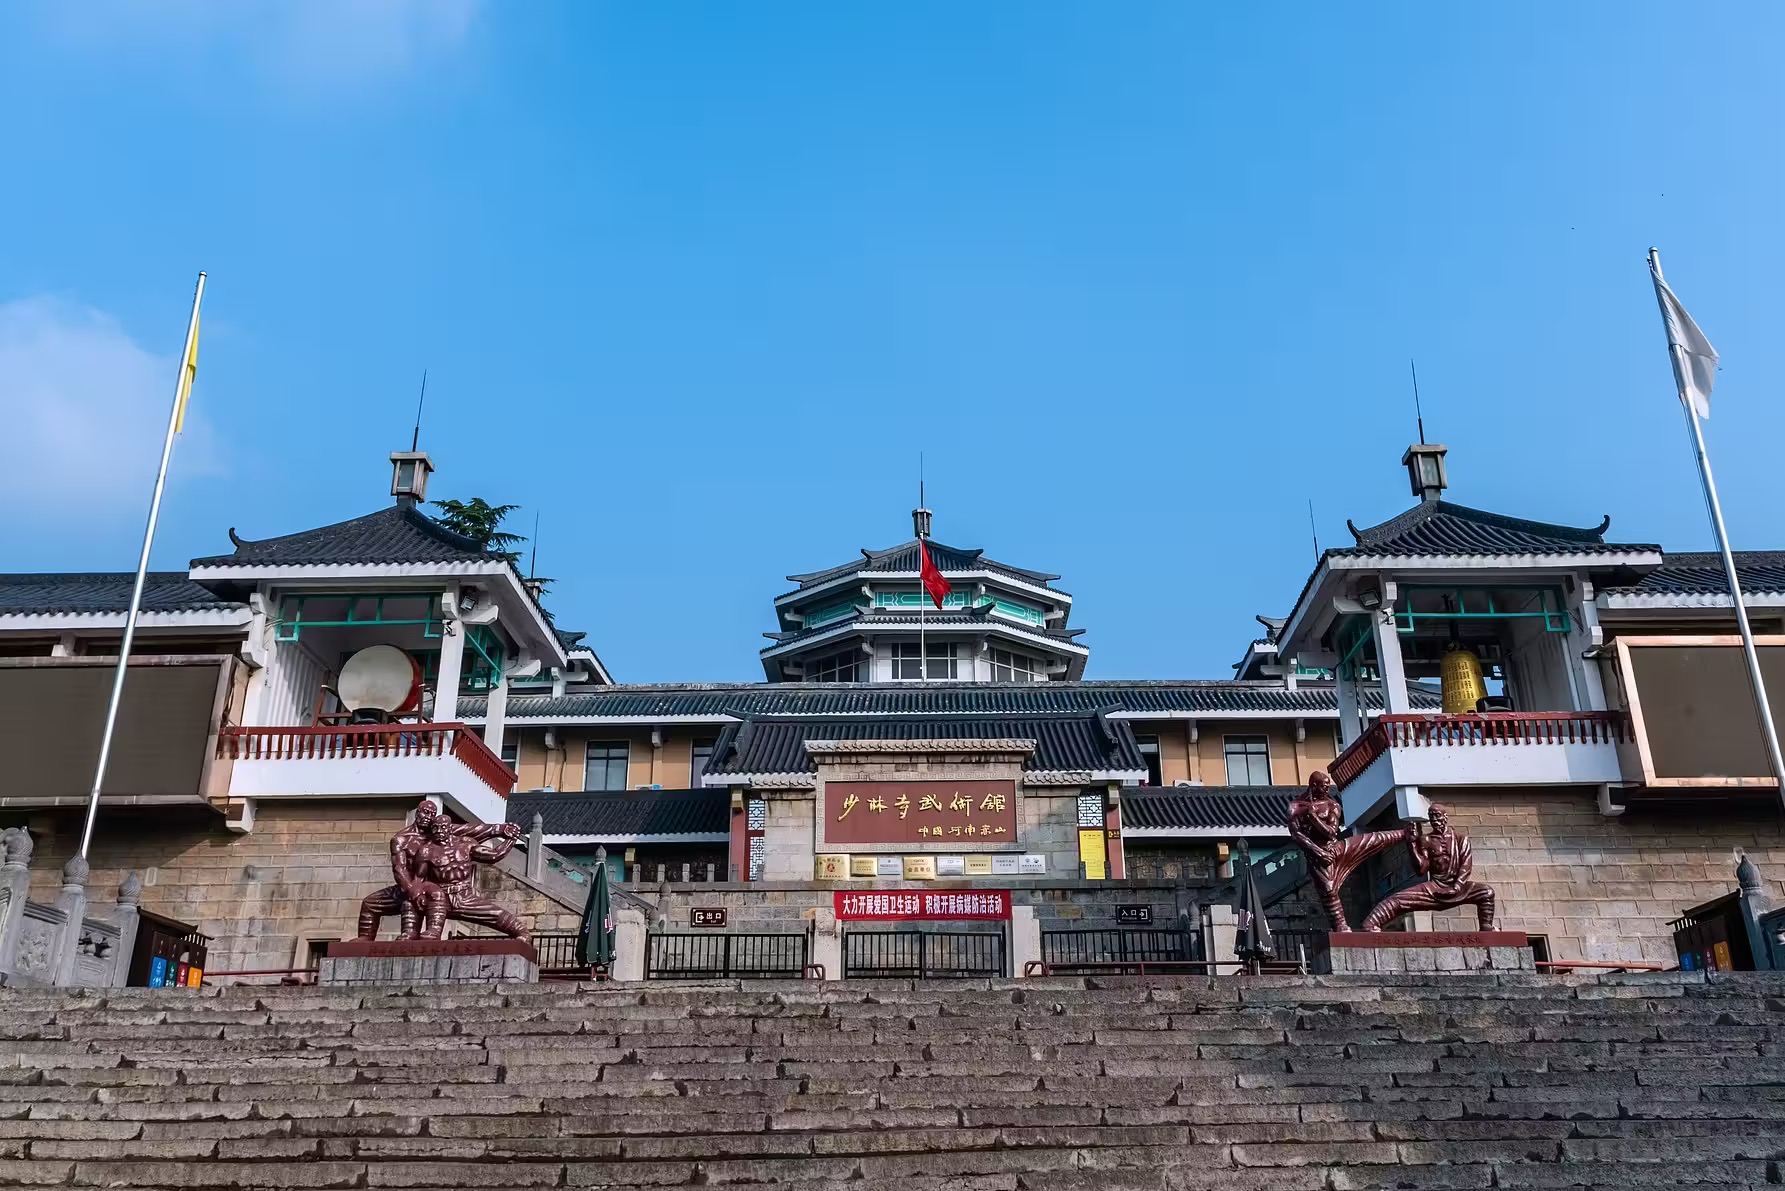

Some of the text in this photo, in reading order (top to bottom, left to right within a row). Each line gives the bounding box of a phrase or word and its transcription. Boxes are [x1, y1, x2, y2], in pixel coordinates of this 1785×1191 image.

[843, 895, 1003, 914] 大力开展爱国卫生运动 积极开展病媒防治活动
[706, 912, 722, 920] 出口
